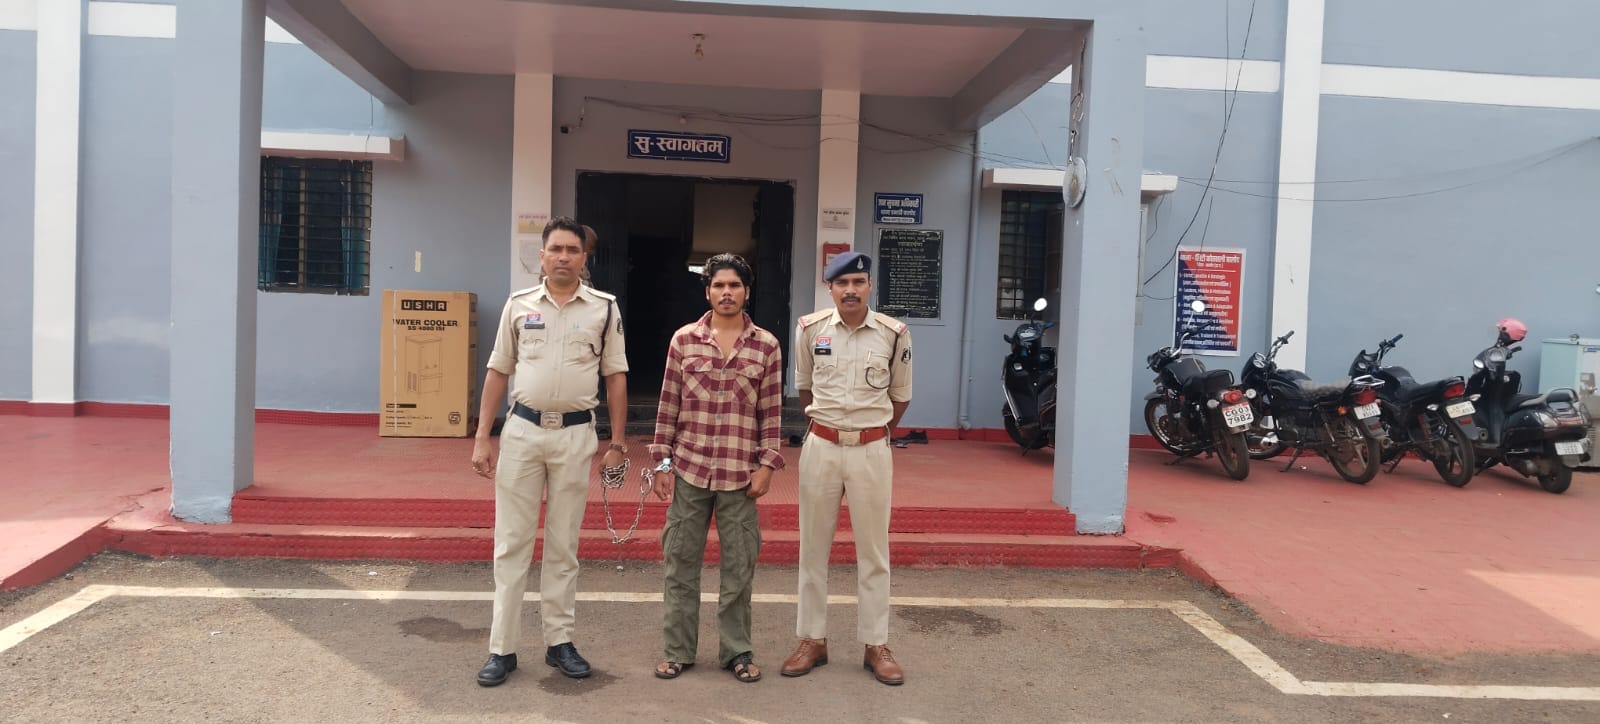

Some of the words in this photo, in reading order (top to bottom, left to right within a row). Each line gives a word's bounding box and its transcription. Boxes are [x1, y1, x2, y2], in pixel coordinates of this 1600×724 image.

[402, 301, 446, 311] USHA
[423, 319, 458, 327] COOLER
[1227, 413, 1252, 425] 7982
